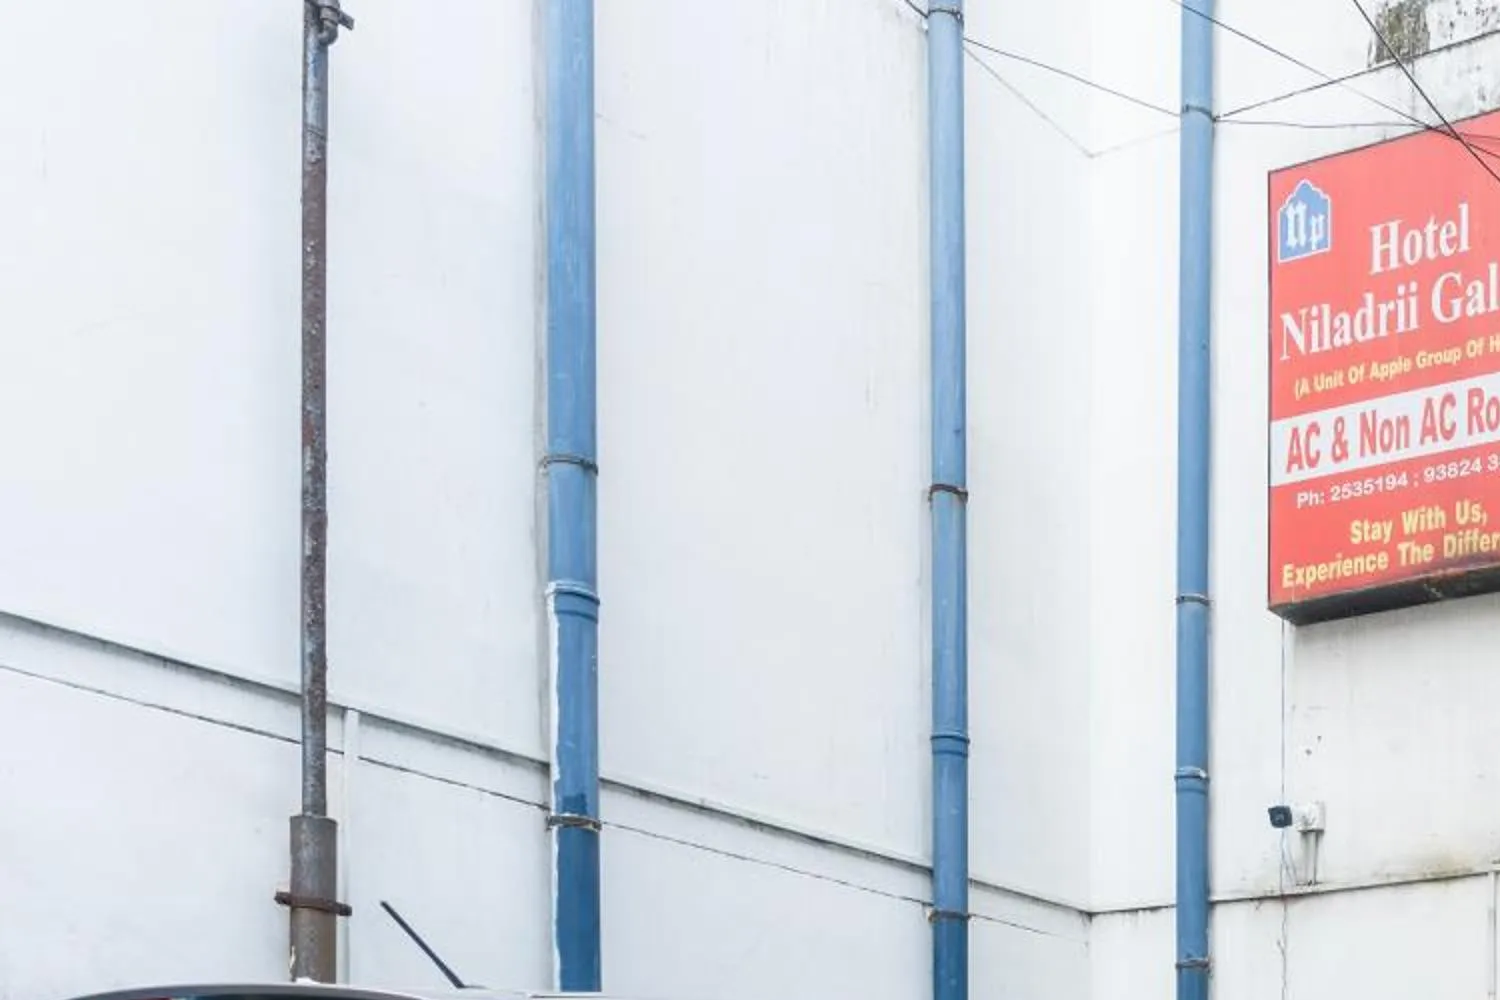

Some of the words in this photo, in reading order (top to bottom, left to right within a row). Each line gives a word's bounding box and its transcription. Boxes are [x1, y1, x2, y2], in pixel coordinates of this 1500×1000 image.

[1369, 203, 1471, 276] Hotel
[1280, 281, 1420, 360] Niladrii
[1314, 371, 1343, 391] Unit
[1349, 365, 1366, 383] Of
[1370, 356, 1412, 386] Apple
[1416, 346, 1461, 374] Group
[1467, 337, 1484, 357] Of
[1285, 421, 1321, 474] AC
[1331, 415, 1349, 465] &
[1359, 409, 1410, 459] Non
[1420, 392, 1457, 445] AC
[1297, 490, 1325, 509] Ph:
[1330, 471, 1408, 502] 2535194
[1350, 518, 1393, 545] Stay
[1402, 506, 1446, 535] With
[1455, 499, 1488, 526] Us,
[1282, 549, 1389, 589] Experience
[1398, 540, 1433, 567] The
